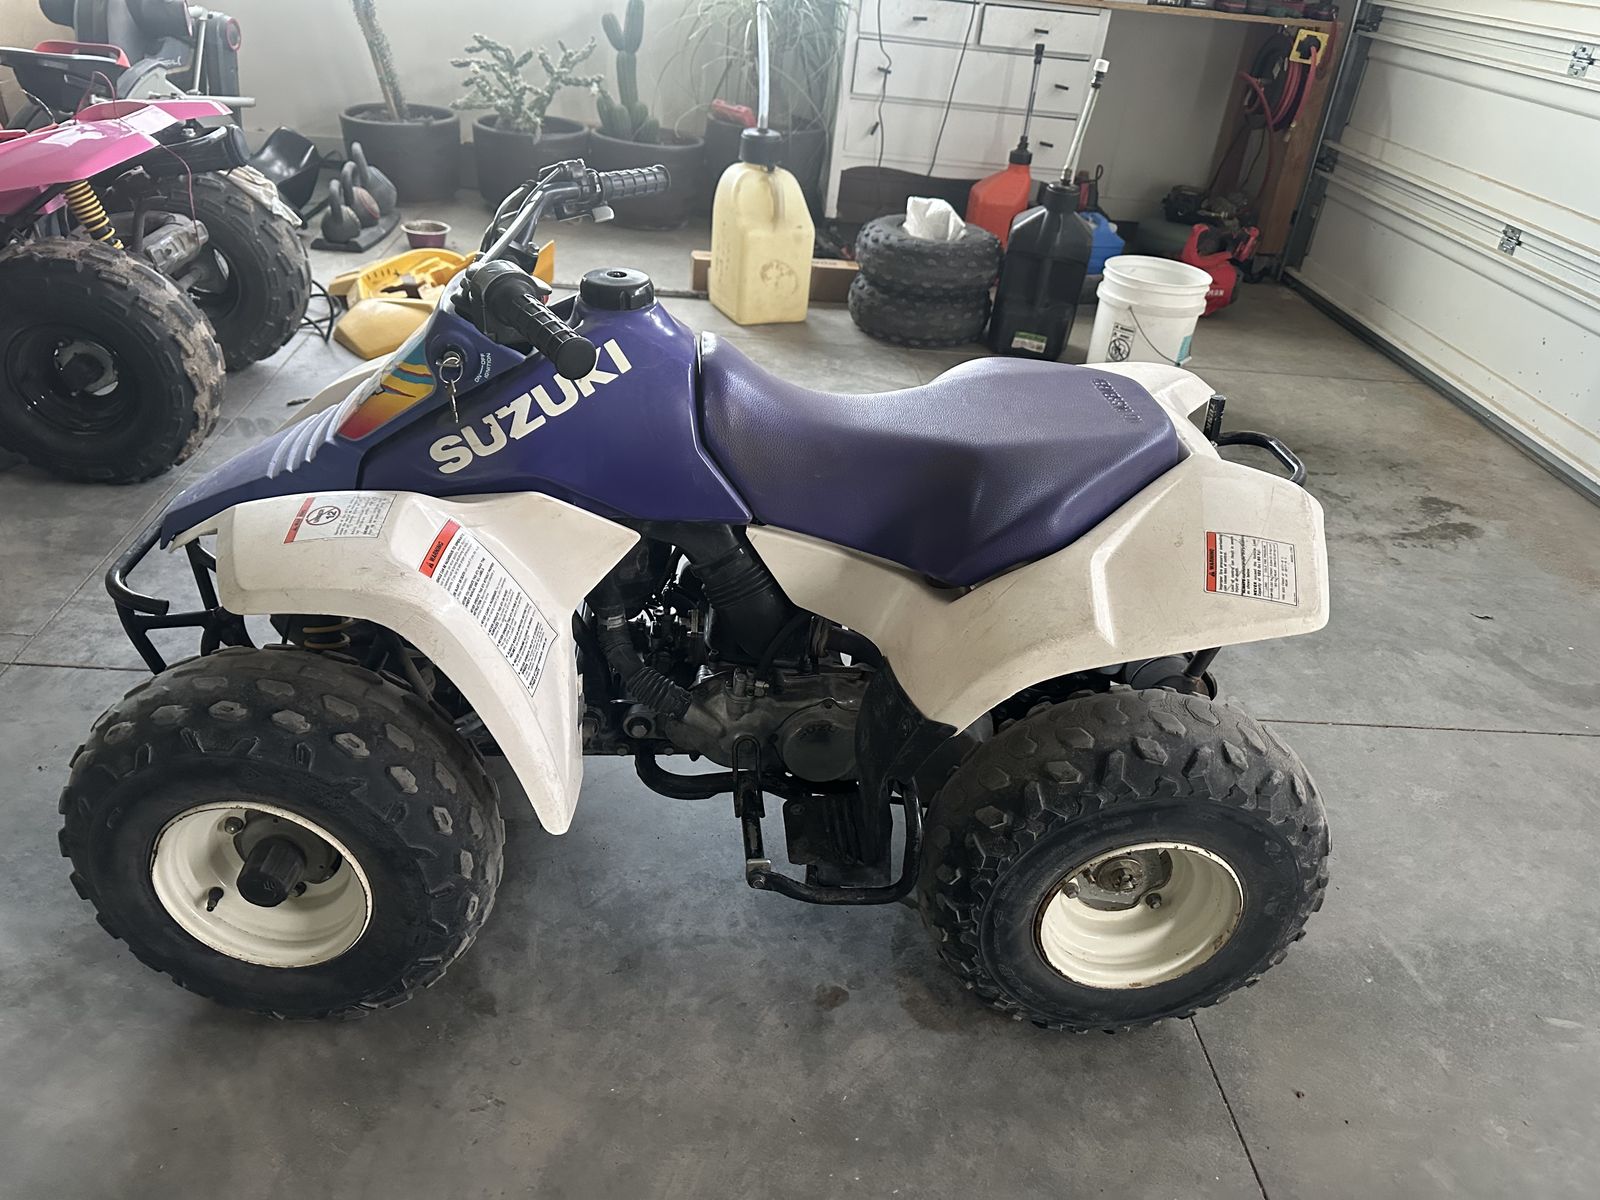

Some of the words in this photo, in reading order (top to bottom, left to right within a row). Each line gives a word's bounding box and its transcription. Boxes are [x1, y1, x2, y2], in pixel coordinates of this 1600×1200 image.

[429, 338, 632, 474] SUZUKI
[325, 506, 338, 521] 12
[431, 541, 444, 562] WARNING
